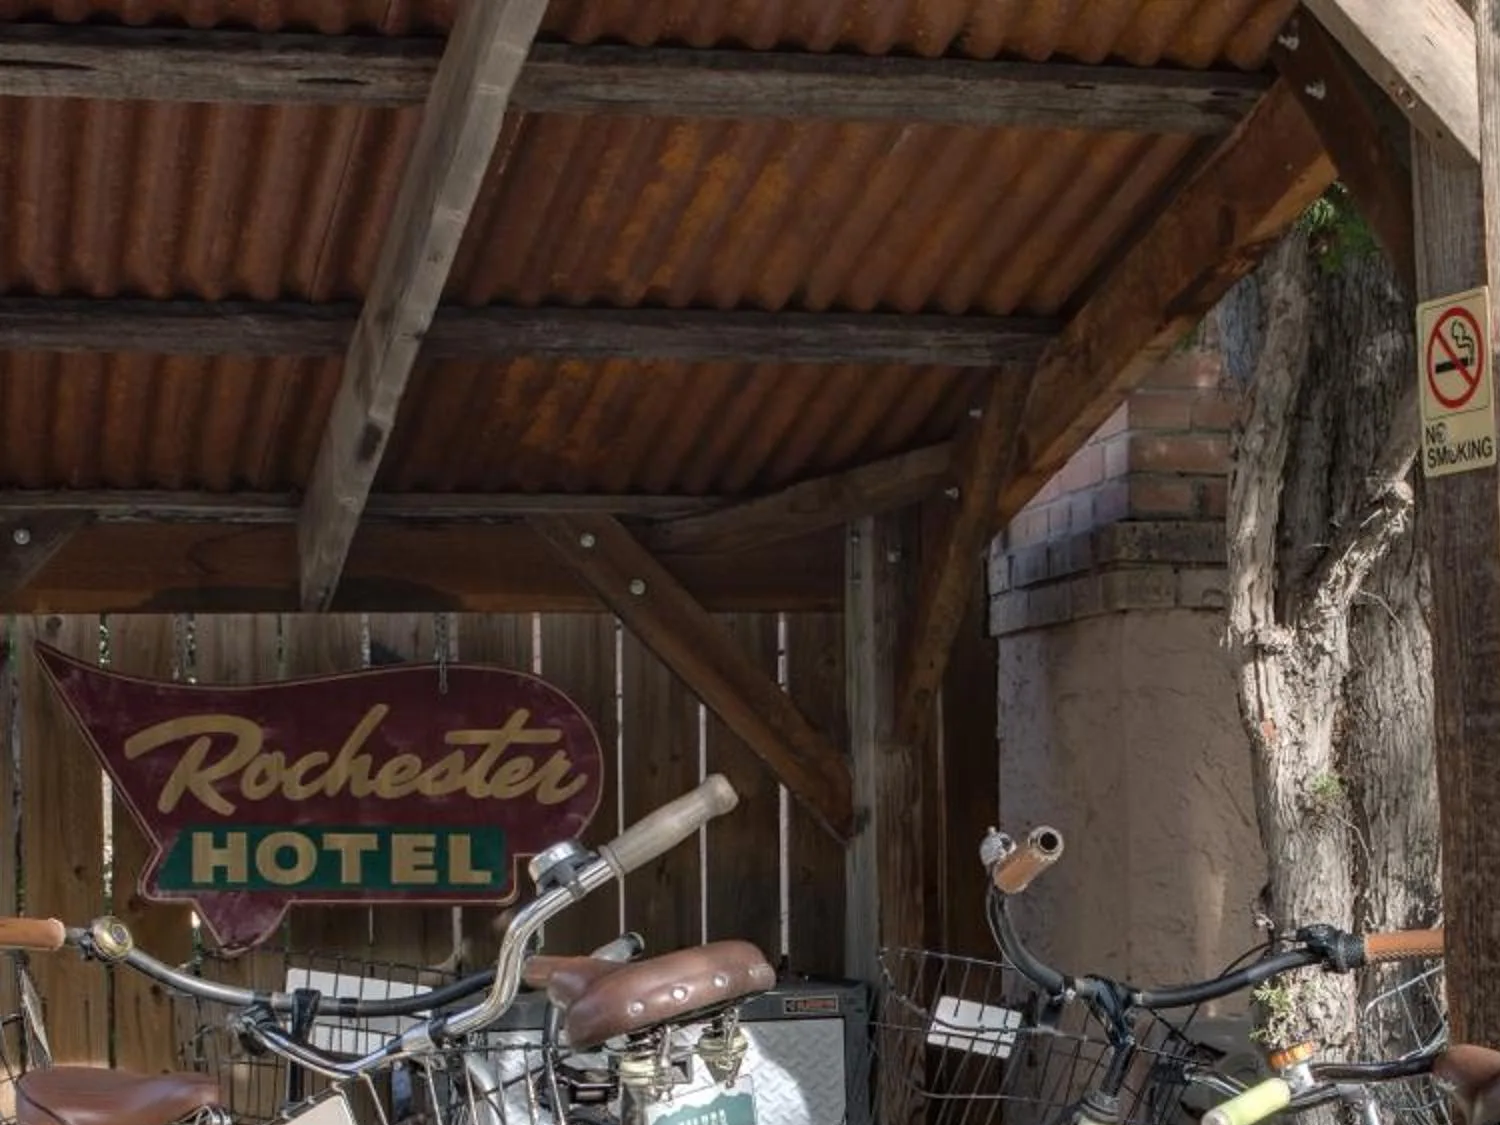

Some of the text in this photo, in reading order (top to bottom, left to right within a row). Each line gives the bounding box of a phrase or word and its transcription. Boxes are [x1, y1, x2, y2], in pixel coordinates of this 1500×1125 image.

[1425, 423, 1447, 446] NO
[1427, 437, 1492, 468] SMOKING
[124, 704, 586, 816] Rochester
[192, 832, 491, 884] HOTEL
